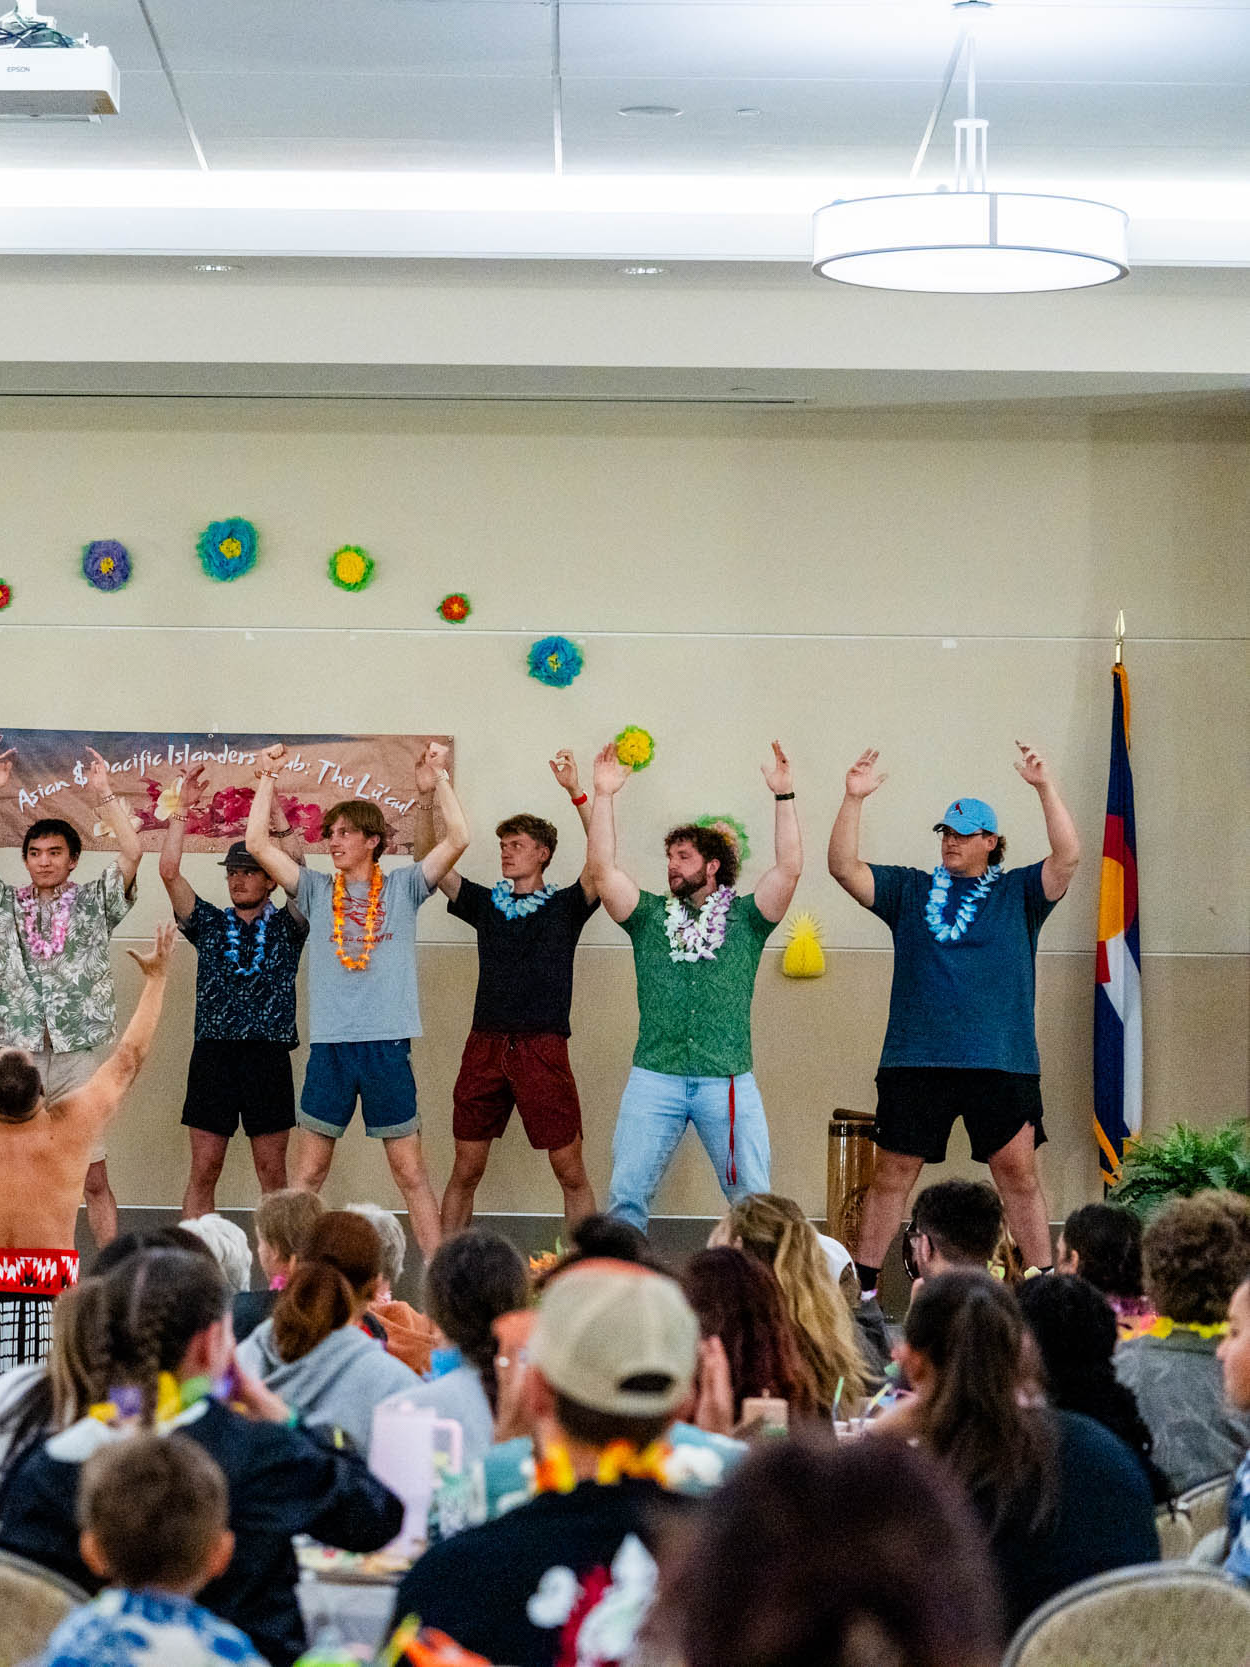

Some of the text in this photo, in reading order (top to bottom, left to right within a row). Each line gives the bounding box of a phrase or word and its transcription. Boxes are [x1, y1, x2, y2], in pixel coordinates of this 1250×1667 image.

[18, 780, 71, 814] Asian
[72, 760, 88, 788] &
[167, 743, 257, 767] Islanders
[283, 753, 311, 775] ub:
[317, 759, 356, 788] The
